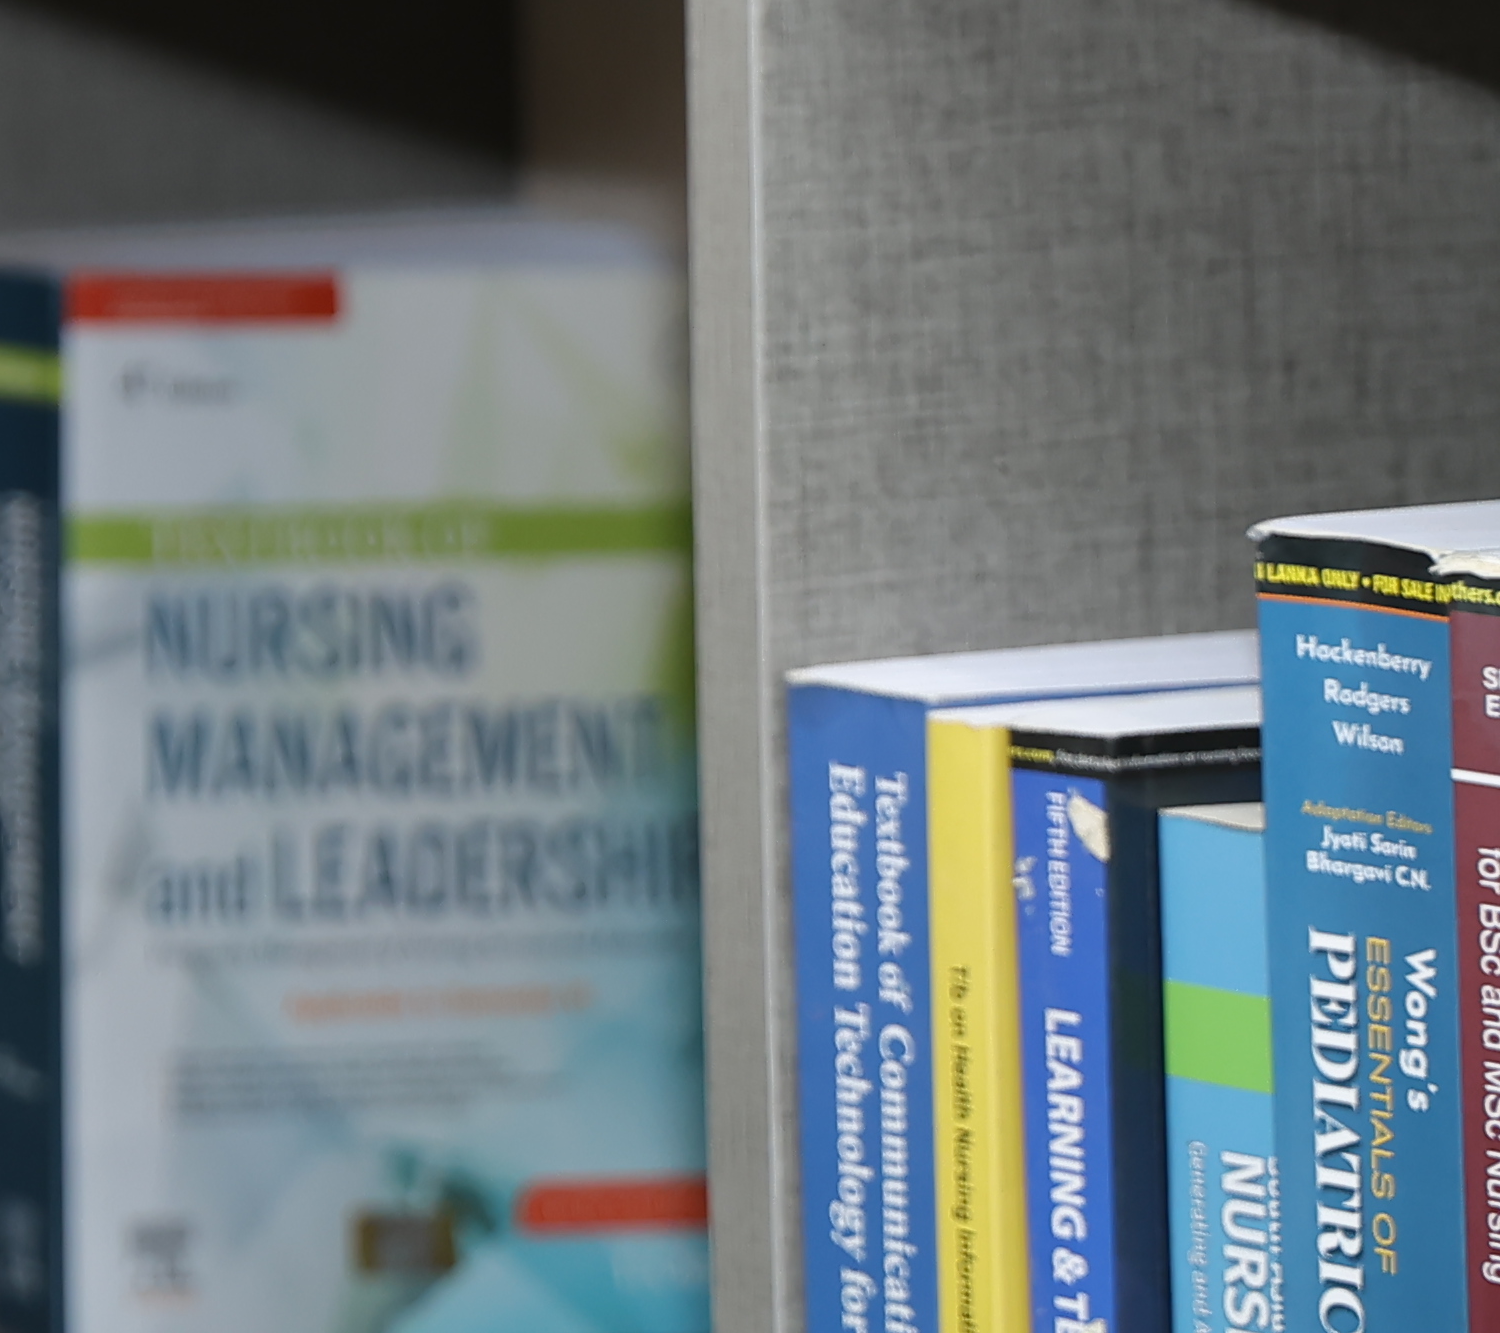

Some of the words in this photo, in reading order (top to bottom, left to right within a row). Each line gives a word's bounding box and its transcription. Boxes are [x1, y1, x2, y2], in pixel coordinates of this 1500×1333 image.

[1266, 561, 1321, 587] LANKA
[1320, 568, 1361, 591] ONLY
[1371, 574, 1401, 596] FOR
[1400, 578, 1436, 603] SALE
[145, 579, 485, 683] NURSING
[1295, 633, 1433, 682] Hockenberry
[1322, 676, 1412, 716] Rodgers
[147, 694, 668, 801] MANAGEMENT
[1331, 719, 1405, 755] Wilson
[1044, 790, 1069, 860] FIFTH
[1301, 798, 1385, 826] Adaptation
[1320, 823, 1368, 852] Jyoti
[1369, 832, 1419, 861] Sarin
[145, 851, 250, 927] and
[827, 759, 870, 993] Education
[874, 771, 912, 961] Textbook
[1305, 848, 1393, 885] Bhargavi
[1048, 859, 1072, 957] EDITION
[878, 965, 914, 1017] of
[1364, 934, 1398, 1201] ESSENTIALS
[1398, 947, 1440, 1114] Wong's
[950, 1042, 975, 1121] Health
[828, 1000, 875, 1263] Technology
[1045, 1006, 1088, 1243] LEARNING
[1307, 925, 1368, 1333] PEDIATRIC
[949, 1125, 975, 1228] Nursing
[1185, 1139, 1210, 1267] Generating
[1051, 1246, 1090, 1286] &
[1371, 1211, 1399, 1277] OF
[839, 1265, 879, 1333] for
[1190, 1268, 1213, 1318] and
